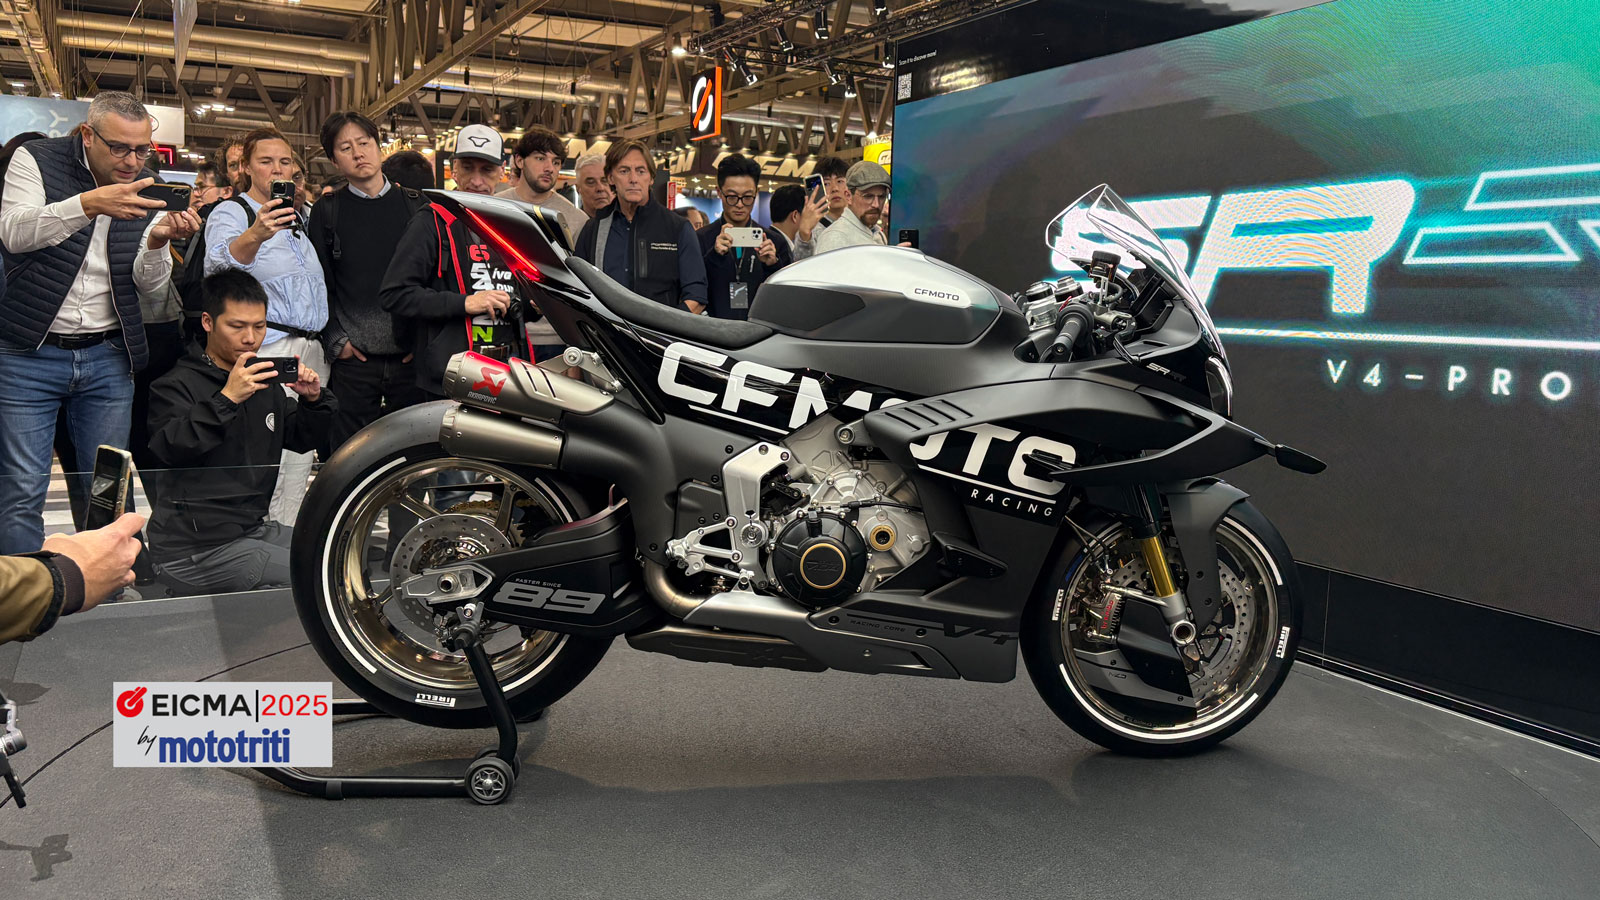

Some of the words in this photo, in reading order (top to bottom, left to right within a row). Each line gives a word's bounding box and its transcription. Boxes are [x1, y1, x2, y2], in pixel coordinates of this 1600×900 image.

[914, 287, 960, 301] CFMOTO
[472, 326, 494, 343] N
[970, 489, 1054, 517] RACING
[515, 578, 541, 586] FASTER
[492, 581, 606, 615] 89
[1275, 625, 1291, 660] PIRELLI
[414, 692, 457, 708] PIRELLI
